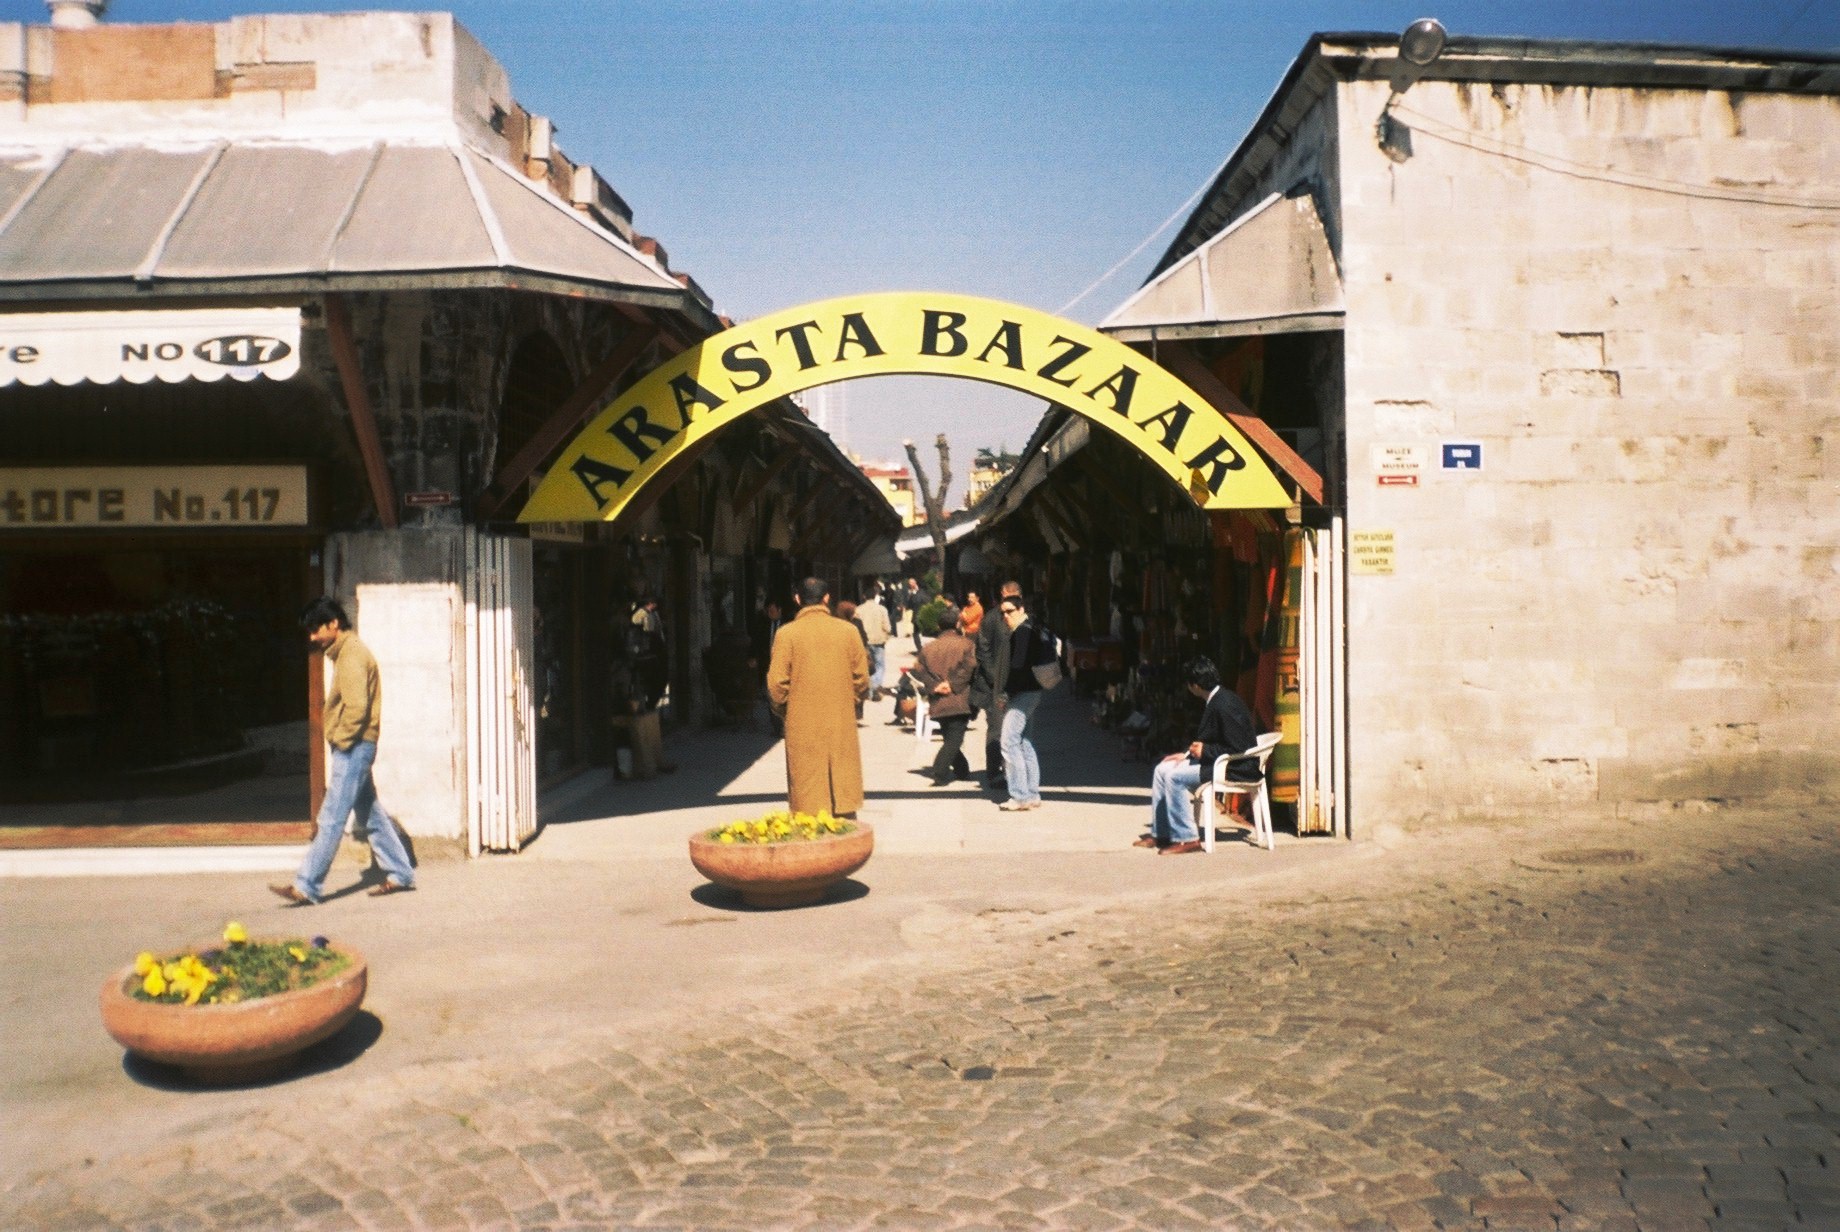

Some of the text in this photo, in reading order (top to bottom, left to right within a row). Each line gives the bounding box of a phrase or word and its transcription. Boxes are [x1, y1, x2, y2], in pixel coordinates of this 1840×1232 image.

[121, 342, 184, 362] NO
[200, 338, 281, 363] 117
[568, 308, 1247, 511] ARASTA BAZAAR
[153, 487, 281, 522] No.117
